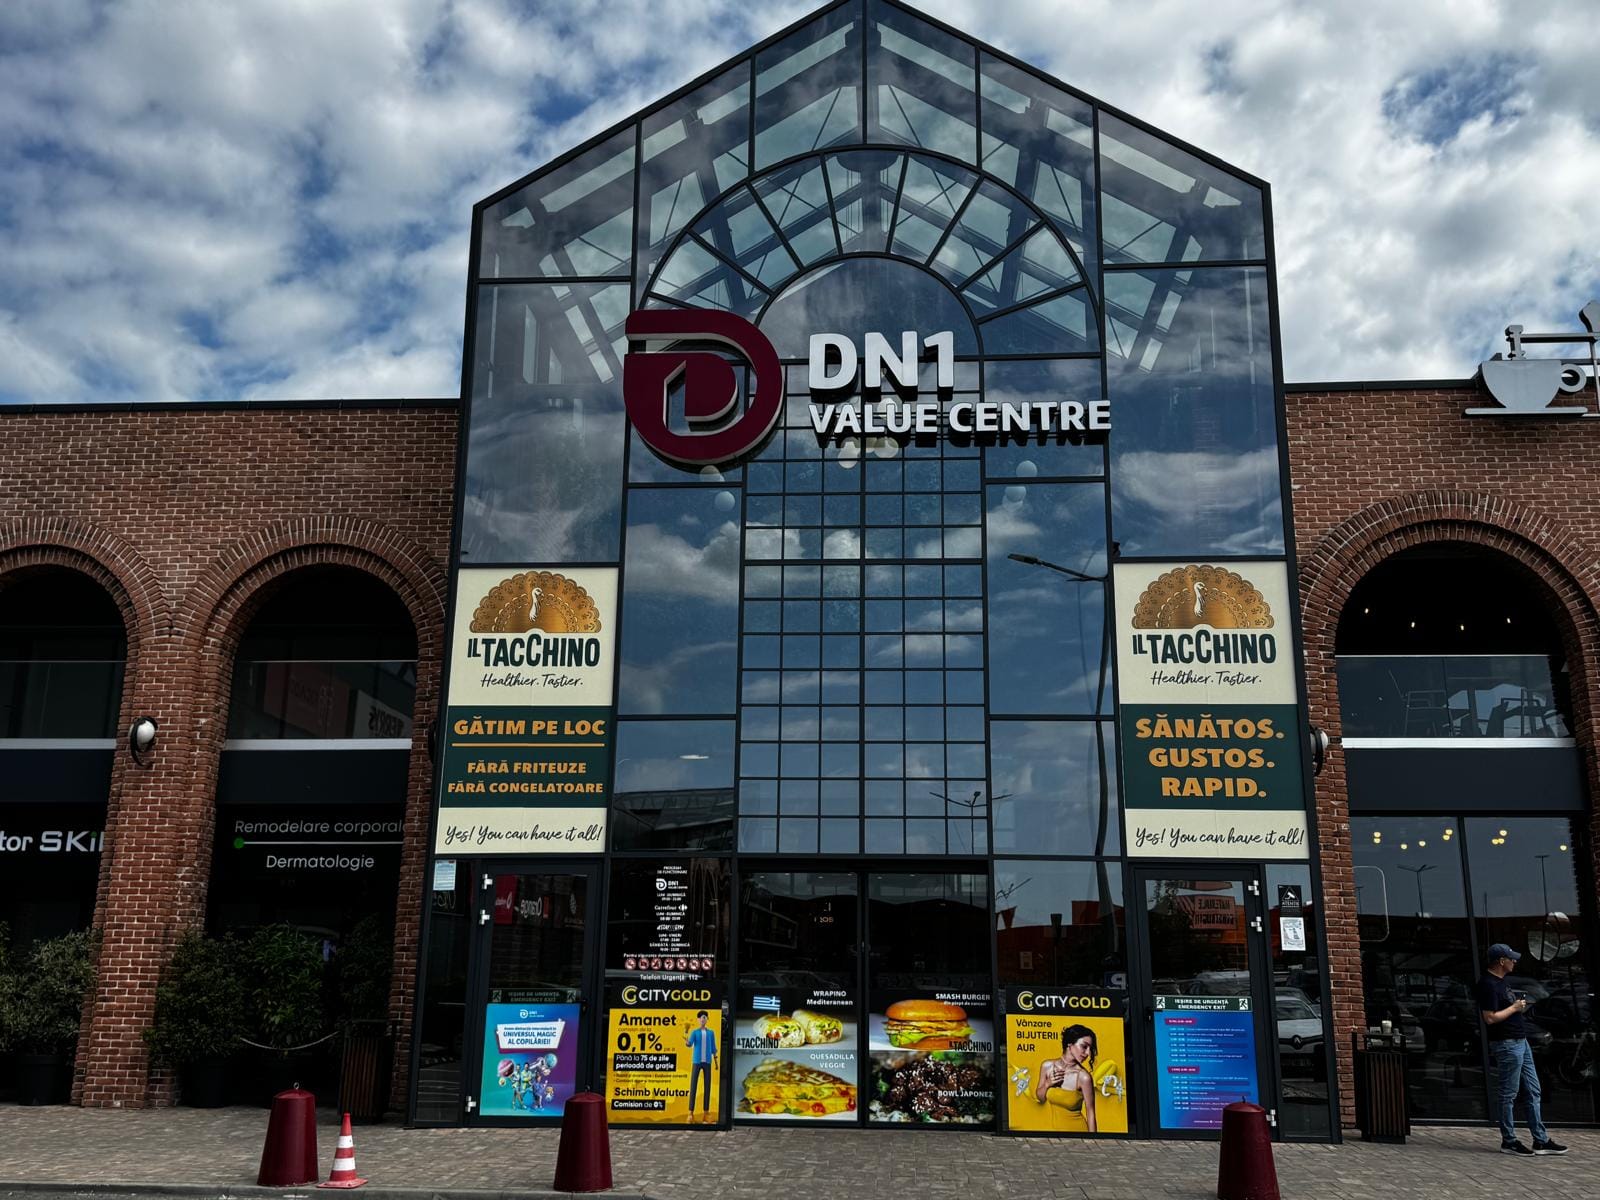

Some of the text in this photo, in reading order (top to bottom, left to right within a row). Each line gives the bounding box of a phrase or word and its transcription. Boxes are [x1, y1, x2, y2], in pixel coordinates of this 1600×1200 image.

[808, 330, 955, 390] DN1
[808, 400, 1112, 434] VALUE CENTRE
[467, 638, 481, 658] IL
[1132, 634, 1147, 655] IL
[481, 672, 584, 688] Healthier. Tastier.
[1151, 670, 1262, 686] Healthier. Tastier.
[454, 715, 605, 736] GĂTIM PE LOC
[1135, 713, 1285, 739] SĂNĂTOS.
[1149, 748, 1275, 768] GUSTOS.
[467, 759, 587, 774] FĂRĂ FRITEUZE
[448, 780, 603, 793] FĂRĂ CONGELATOARE
[1161, 777, 1267, 798] RAPID.
[234, 820, 330, 833] Remodelare
[445, 825, 604, 845] Yes! You can have it all!
[1135, 827, 1306, 847] Yes! You can have it all!
[266, 855, 375, 871] Dermatologie
[638, 989, 711, 1001] CITYGOLD
[1034, 995, 1111, 1009] CITYGOLD
[619, 1013, 677, 1027] Amanet
[1015, 1018, 1053, 1028] Vânzare
[617, 1032, 663, 1052] 0,1%
[1016, 1031, 1059, 1040] BIJUTERII
[1016, 1044, 1036, 1052] AUR
[614, 1087, 690, 1097] Schimb Valutar
[960, 1090, 993, 1098] JAPONEZ
